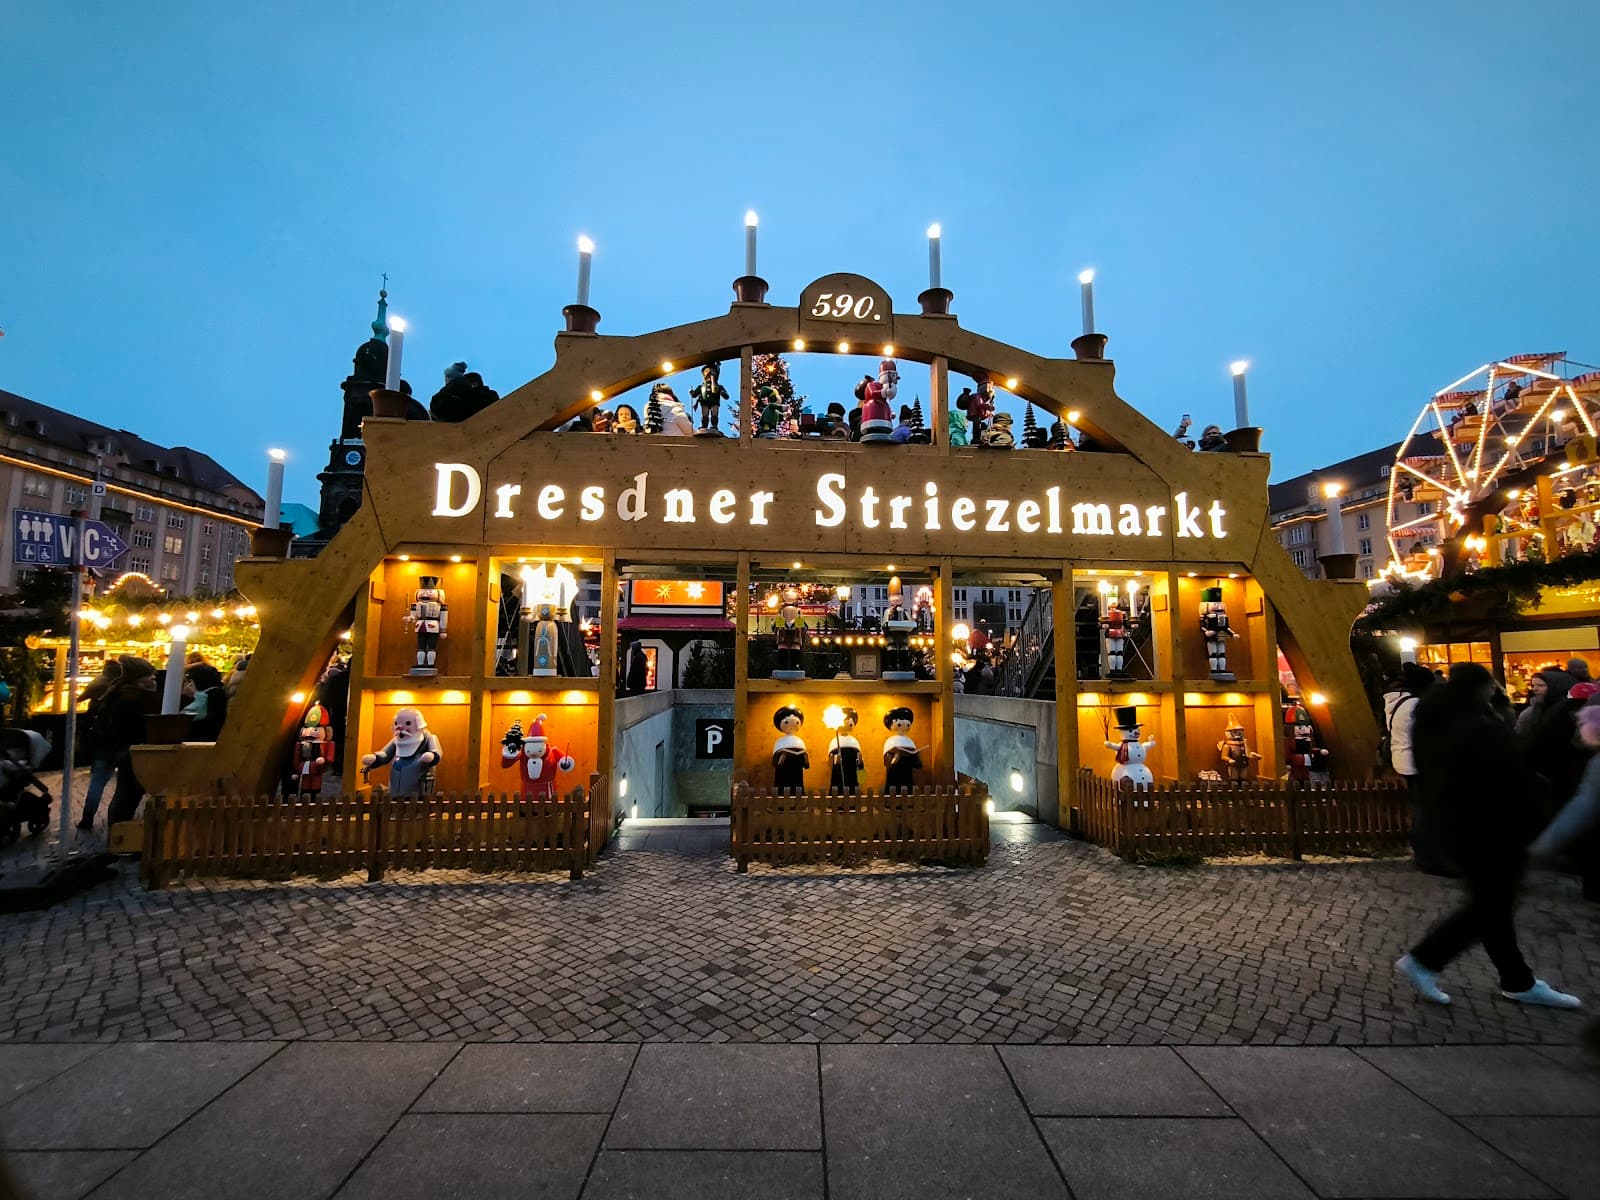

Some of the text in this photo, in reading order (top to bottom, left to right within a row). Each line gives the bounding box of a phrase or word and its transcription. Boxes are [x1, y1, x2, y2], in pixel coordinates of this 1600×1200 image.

[811, 293, 880, 320] 590.
[94, 485, 104, 494] D
[431, 462, 1228, 539] Dresdner Striezelmarkt
[707, 730, 723, 754] P
